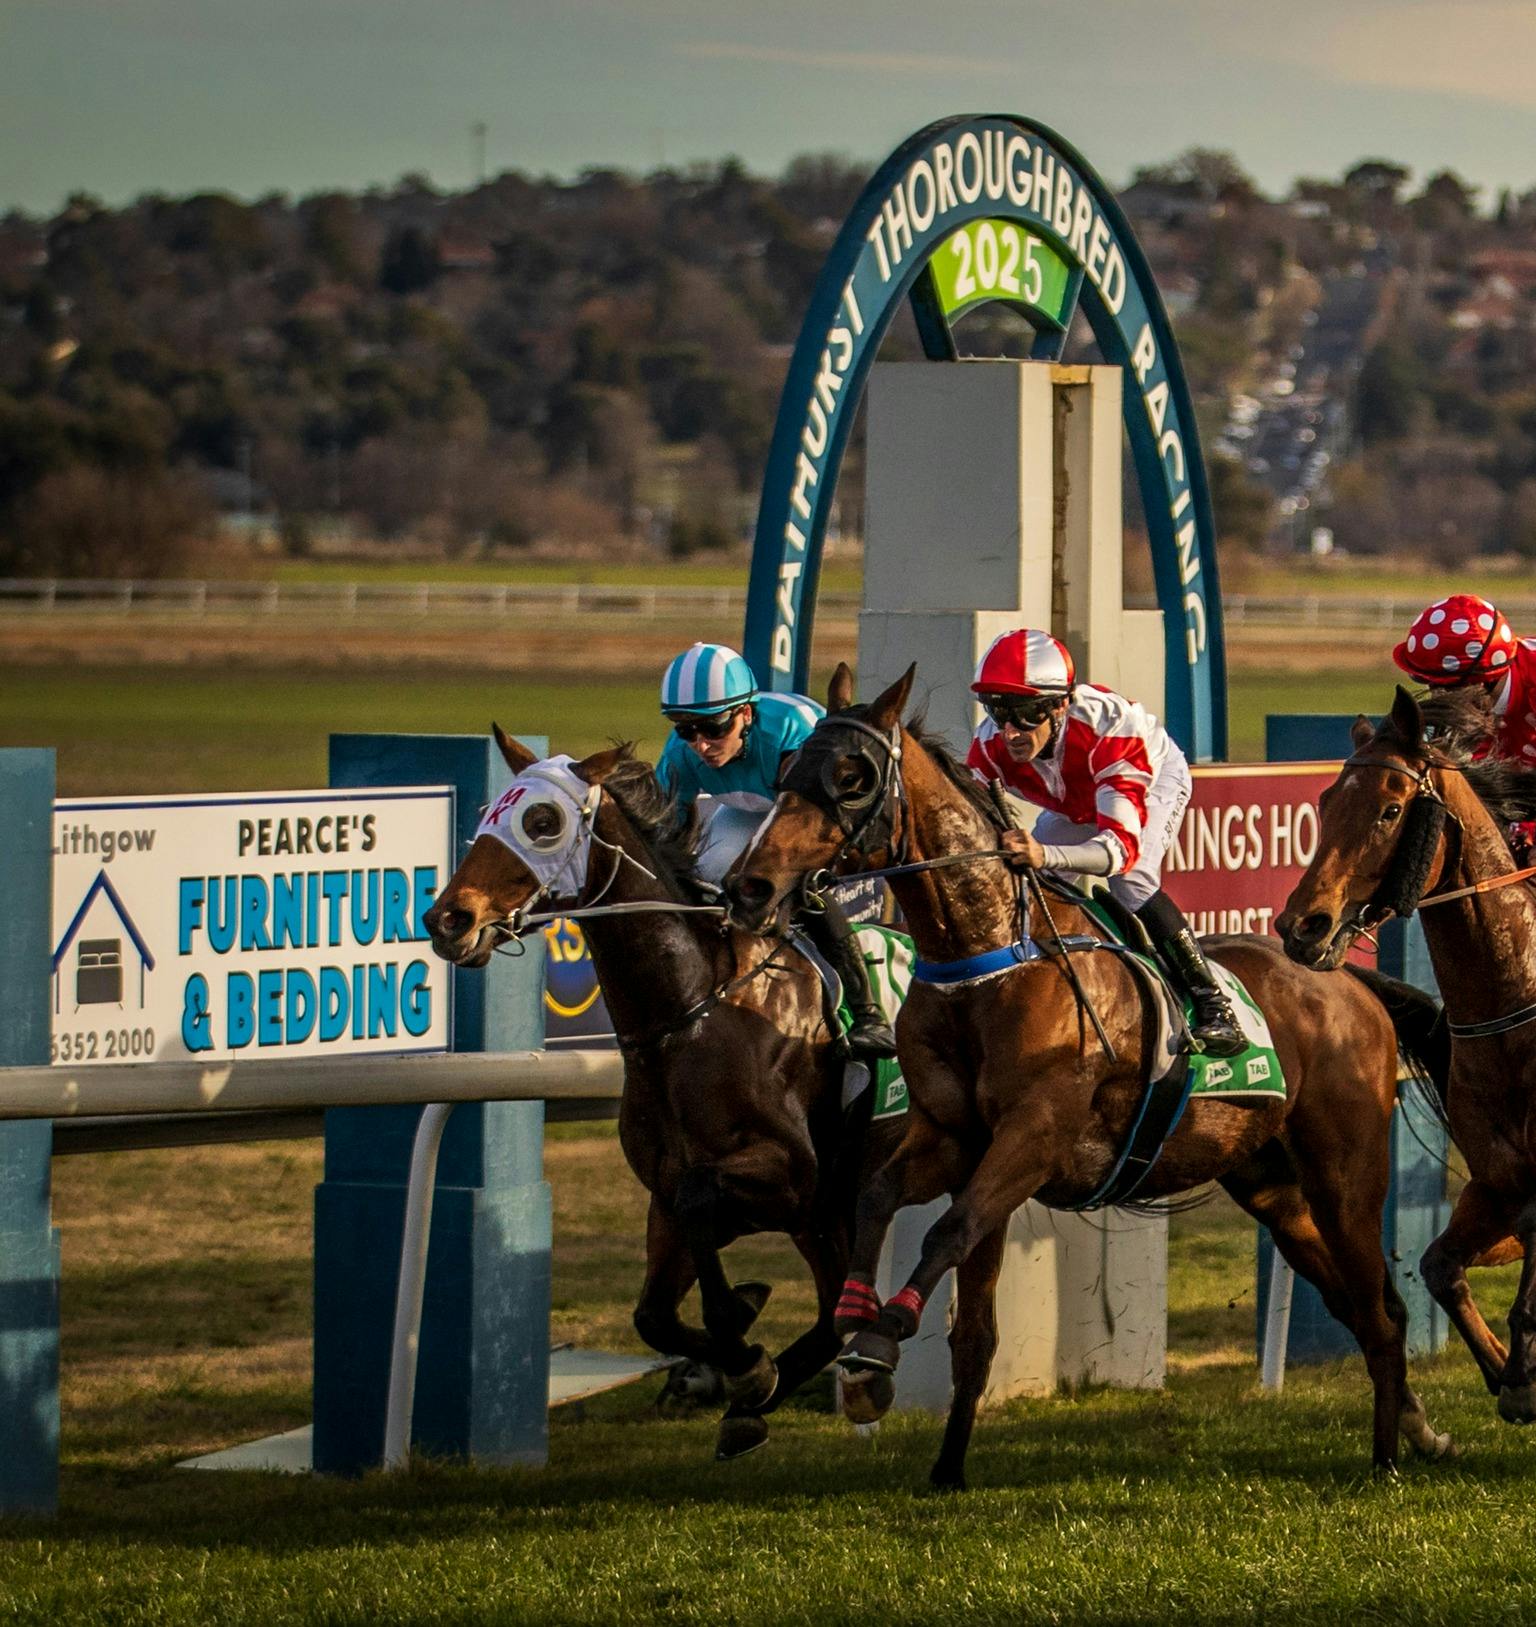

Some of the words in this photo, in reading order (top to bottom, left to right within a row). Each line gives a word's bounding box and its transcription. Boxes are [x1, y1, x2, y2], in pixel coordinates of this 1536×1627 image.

[952, 223, 1043, 304] 2025
[867, 129, 1127, 316] THOROUGHBRED
[1131, 322, 1207, 665] RACING
[238, 813, 377, 857] PEARCE'S
[1270, 802, 1320, 868] HO
[178, 865, 439, 956] FURNITURE
[105, 1027, 156, 1057] 2000
[182, 972, 216, 1053] &
[227, 958, 433, 1050] BEDDING
[1249, 1063, 1268, 1075] TAB
